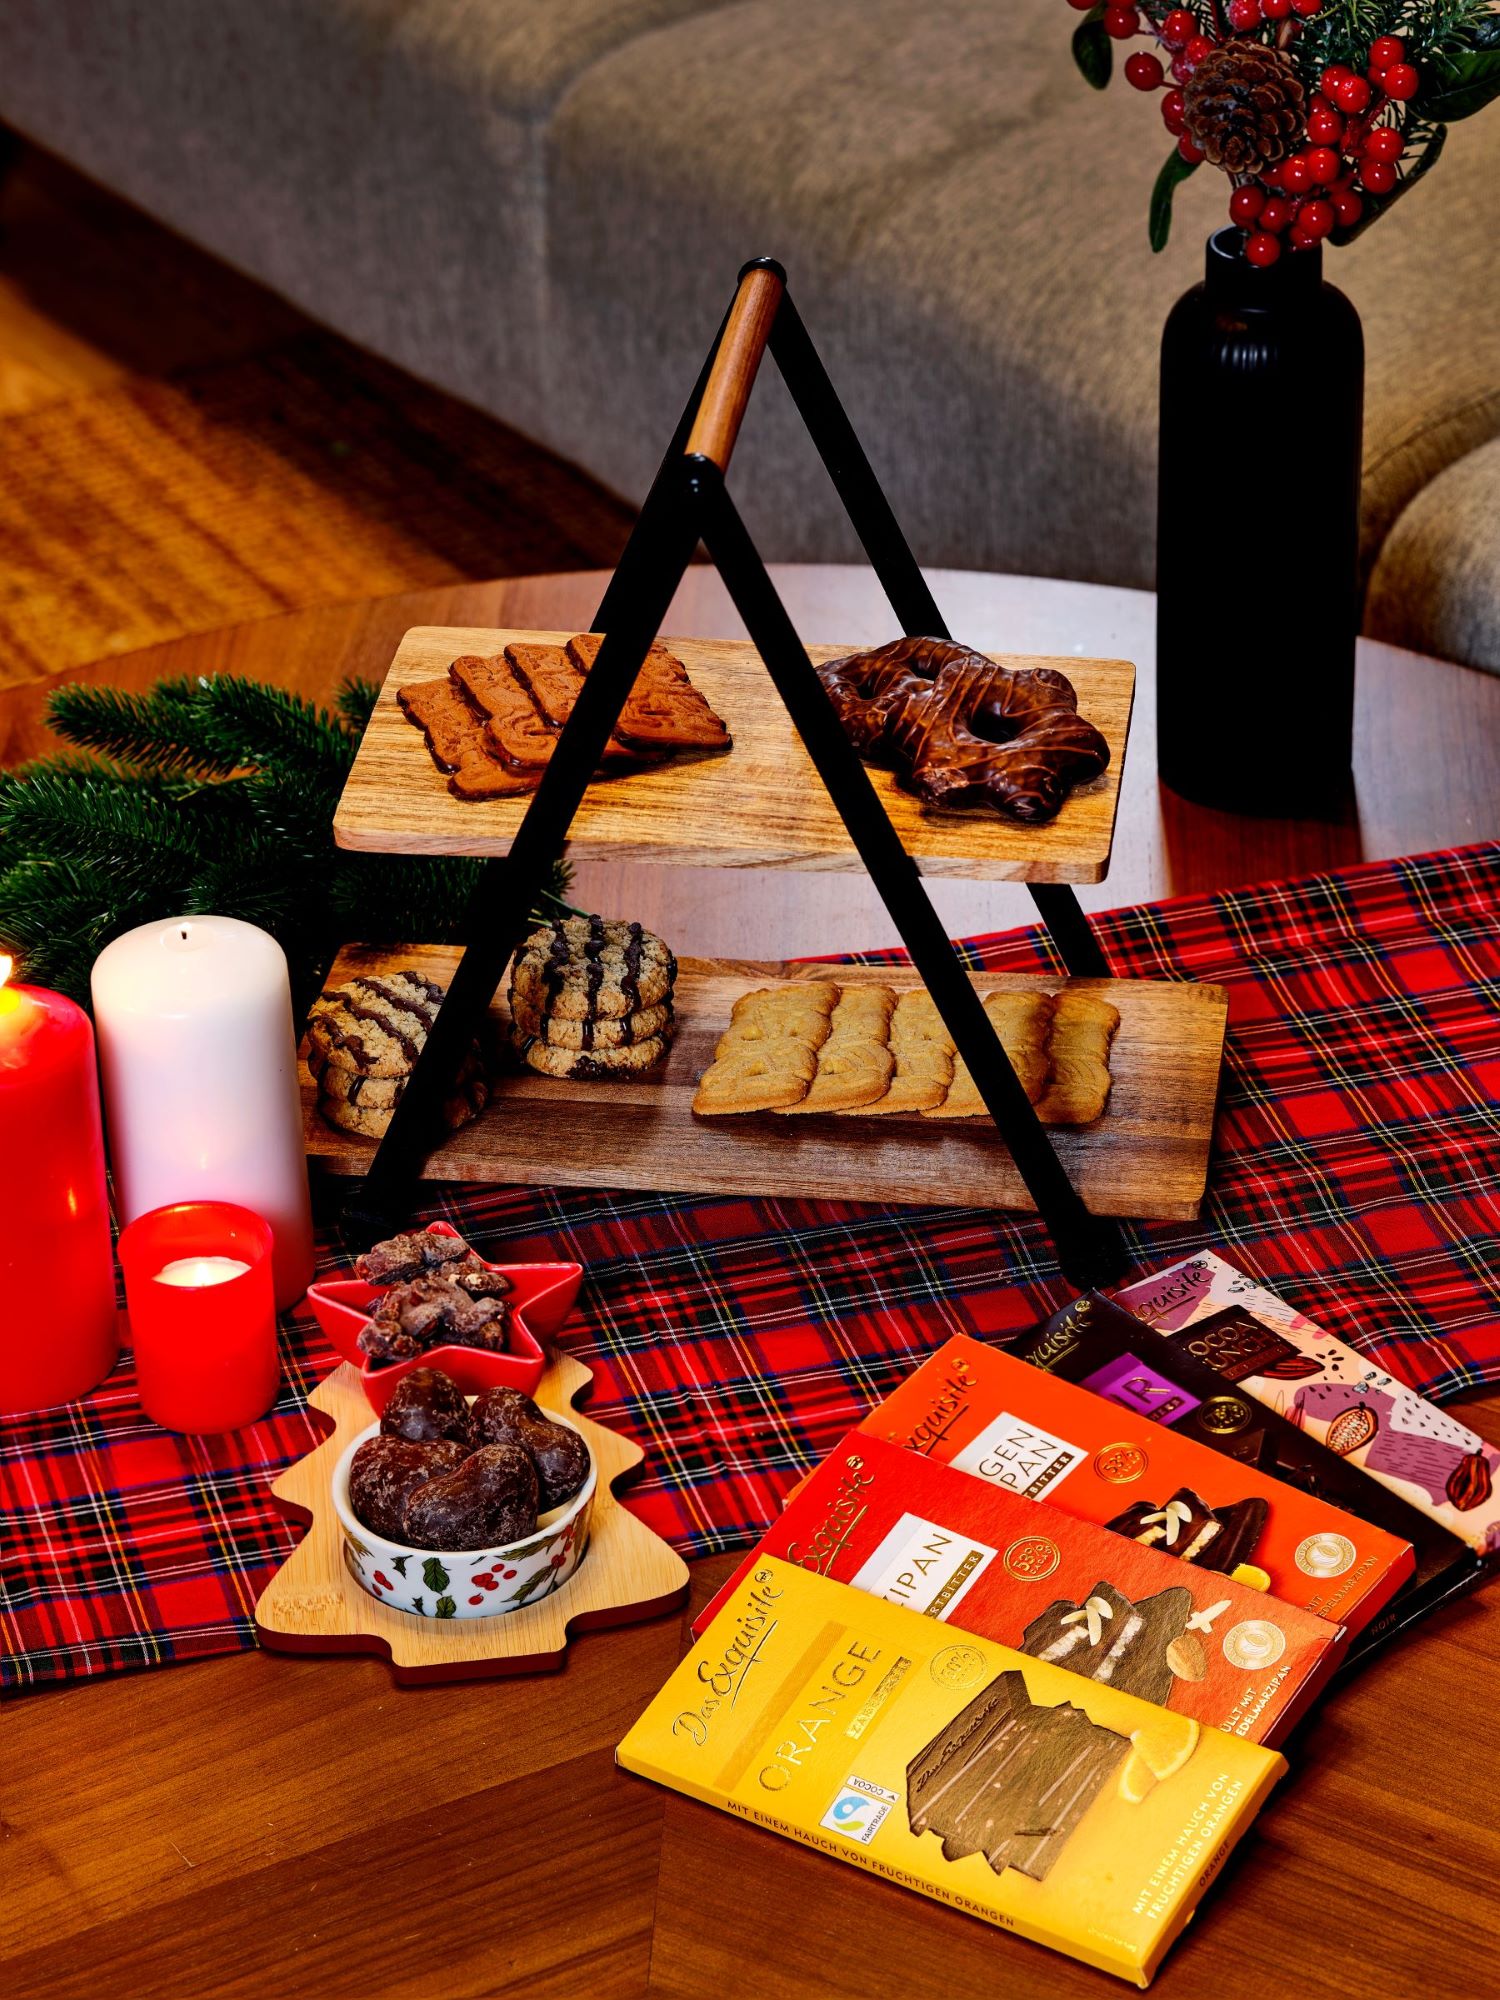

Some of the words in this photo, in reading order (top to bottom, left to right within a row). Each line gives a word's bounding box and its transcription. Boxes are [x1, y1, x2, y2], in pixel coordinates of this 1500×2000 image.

[1025, 1314, 1093, 1369] quisite
[1187, 1321, 1258, 1355] OCOA
[904, 1374, 978, 1450] xquisite
[978, 1428, 1035, 1477] GEN
[1000, 1439, 1058, 1488] PAN
[1024, 1456, 1070, 1498] TBITTER
[885, 1533, 953, 1603] IPAN
[927, 1555, 979, 1617] RTBITTER
[673, 1698, 721, 1747] Das
[697, 1585, 784, 1697] Exquisite
[758, 1641, 881, 1792] ORANGE
[1235, 1665, 1292, 1737] EDELMARZIPAN
[1240, 1687, 1257, 1708] MIT
[852, 1777, 885, 1797] COCOA
[861, 1805, 889, 1842] FAIRTRADE
[1132, 1889, 1153, 1914] MIT
[1149, 1849, 1180, 1887] EINEM
[1175, 1801, 1210, 1848] HAUCH
[1207, 1773, 1230, 1800] VON
[1146, 1840, 1203, 1919] FRUCHTIGEN
[1200, 1780, 1244, 1838] ORANGEN
[727, 1800, 749, 1816] MIT
[754, 1811, 789, 1833] EINEM
[794, 1829, 837, 1853] HAUCH
[842, 1848, 868, 1866] VON
[872, 1861, 950, 1900] FRUCHTIGEN
[955, 1895, 1015, 1927] ORANGEN
[1199, 1839, 1231, 1888] ORANGE
